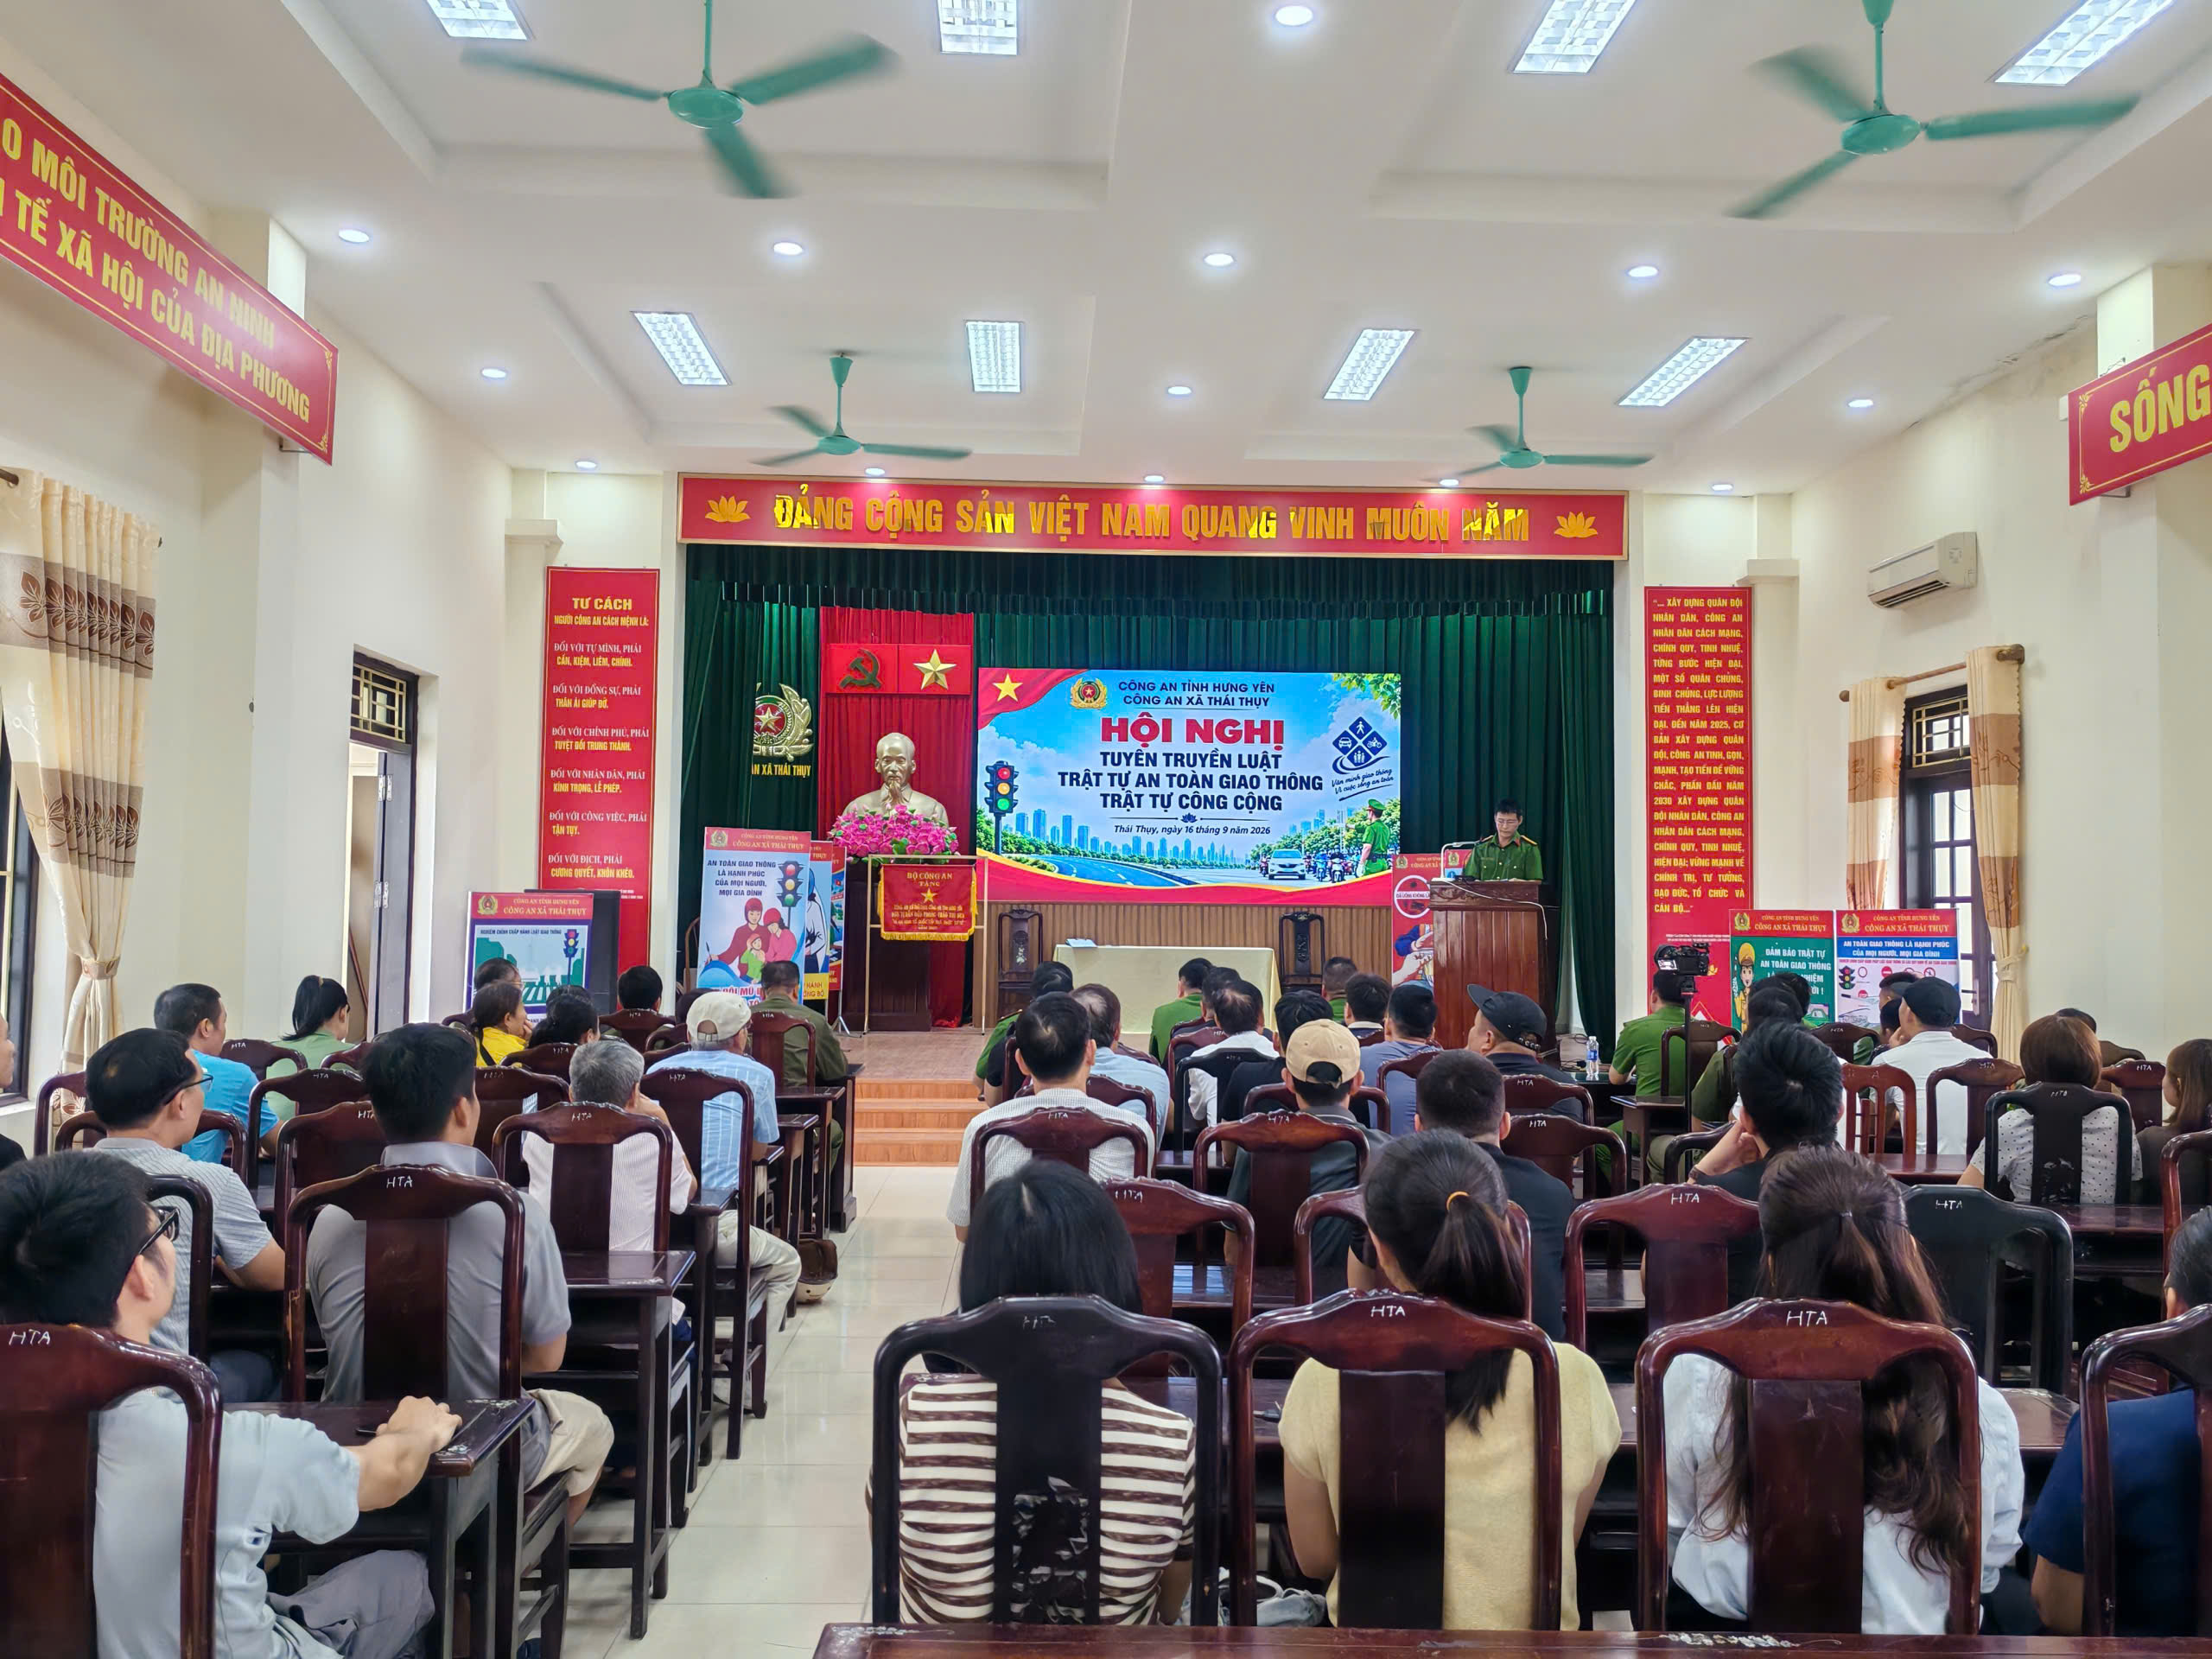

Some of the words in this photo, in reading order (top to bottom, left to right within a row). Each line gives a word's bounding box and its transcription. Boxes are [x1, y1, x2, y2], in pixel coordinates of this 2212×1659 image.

[32, 138, 86, 211] MÔI
[95, 187, 188, 287] TRƯỜNG
[194, 267, 224, 313] AN
[229, 291, 275, 349] NINH
[15, 189, 51, 247] TẾ
[57, 219, 93, 278] XÃ
[102, 252, 143, 311] HỘI
[151, 288, 194, 346] CỦA
[202, 323, 234, 372] ĐỊA
[240, 350, 310, 423] PHƯƠNG
[2110, 365, 2210, 452] SỐNG
[774, 484, 853, 530] ĐẢNG
[866, 491, 944, 538] CỘNG
[957, 489, 1014, 534] SẢN
[1029, 494, 1089, 542] VIỆT
[1102, 503, 1170, 537] NAM
[1182, 504, 1277, 540] QUANG
[1290, 506, 1353, 539] VINH
[1366, 500, 1449, 541] MUÔN
[1462, 502, 1529, 541] NĂM
[572, 597, 591, 609] TƯ
[594, 596, 632, 610] CÁCH
[1667, 597, 1681, 607] XÂY
[1684, 599, 1704, 608] DỰNG
[1707, 597, 1727, 607] QUÂN
[1730, 598, 1742, 608] ĐỘI
[575, 614, 591, 625] CÔNG
[593, 616, 601, 625] AN
[603, 614, 619, 626] CÁCH
[1653, 613, 1674, 622] NHÂN
[1706, 613, 1726, 622] CÔNG
[1732, 613, 1742, 622] AN
[554, 640, 569, 652] ĐỐI
[570, 642, 584, 652] VỚI
[586, 643, 597, 654] TỰ
[623, 643, 641, 653] PHẢI
[1653, 643, 1675, 652] CHÍNH
[1680, 645, 1696, 653] QUY,
[1119, 680, 1155, 691] CÔNG
[1160, 683, 1177, 691] AN
[1181, 680, 1209, 691] TỈNH
[1213, 682, 1248, 692] HƯNG
[1253, 682, 1274, 693] YÊN
[1123, 693, 1160, 705] CÔNG
[1165, 696, 1182, 705] AN
[1186, 696, 1204, 705] XÃ
[1208, 695, 1234, 706] THÁI
[1239, 697, 1269, 709] THỤY
[1672, 718, 1687, 728] ĐẾN
[1690, 719, 1707, 728] NĂM
[1711, 721, 1730, 729] 2025,
[1101, 712, 1173, 748] HỘI
[1185, 719, 1284, 751] NGHỊ
[1100, 749, 1158, 767] TUYÊN
[1163, 748, 1232, 768] TRUYỀN
[1238, 752, 1282, 772] LUẬT
[762, 763, 772, 775] XÃ
[774, 763, 791, 775] THÁI
[793, 766, 810, 778] THỤY
[1058, 769, 1103, 790] TRẬT
[1108, 771, 1130, 791] TỰ
[1135, 774, 1160, 788] AN
[1166, 770, 1213, 789] TOÀN
[1219, 774, 1260, 790] GIAO
[1265, 772, 1323, 791] THÔNG
[1100, 791, 1144, 811] TRẬT
[1149, 792, 1173, 812] TỰ
[1179, 791, 1228, 810] CÔNG
[1234, 792, 1282, 814] CỘNG
[550, 810, 563, 821] ĐỐI
[566, 811, 579, 821] VỚI
[582, 810, 603, 821] CÔNG
[1136, 825, 1159, 835] Thụy,
[1161, 826, 1182, 835] ngày
[1196, 825, 1220, 835] tháng
[1933, 939, 1949, 948] PHÚC
[1783, 947, 1796, 957] BẢO
[1797, 948, 1815, 958] TRẬT
[1816, 950, 1825, 958] TỰ
[1772, 959, 1789, 969] TOÀN
[1808, 961, 1831, 970] THÔNG
[669, 1073, 685, 1082] HTA
[571, 1112, 592, 1122] HTA
[1048, 1111, 1069, 1120] HTA
[387, 1175, 413, 1189] HTA
[1671, 1192, 1700, 1205] HTA
[1936, 1200, 1963, 1210] HTA
[1370, 1306, 1406, 1317] HTA
[1787, 1311, 1828, 1325] HTA
[9, 1330, 51, 1346] HTA
